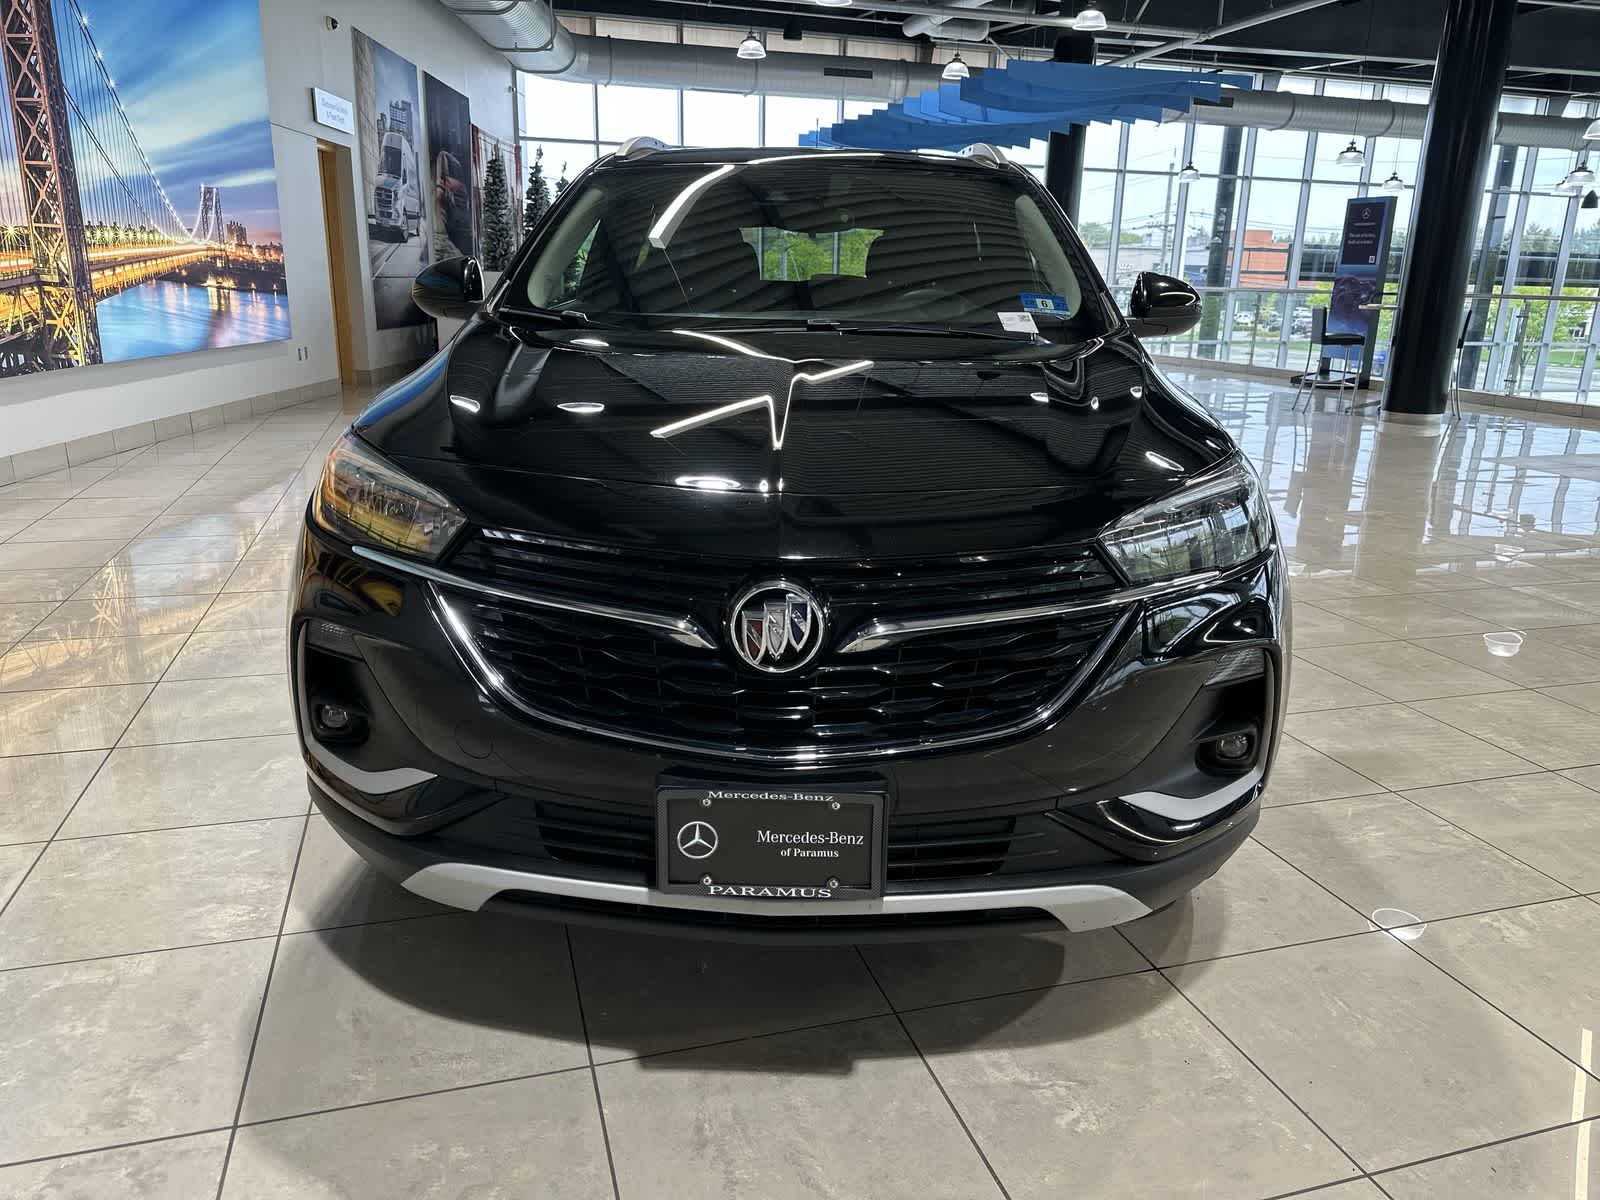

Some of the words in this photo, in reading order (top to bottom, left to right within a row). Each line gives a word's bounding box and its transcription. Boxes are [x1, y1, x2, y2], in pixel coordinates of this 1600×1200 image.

[1041, 300, 1049, 308] 6
[707, 790, 834, 802] Mercedes-Benz
[757, 830, 864, 845] Mercedes-Benz
[780, 848, 792, 858] of
[793, 848, 839, 858] Paramus
[707, 885, 832, 898] PARAMUS
